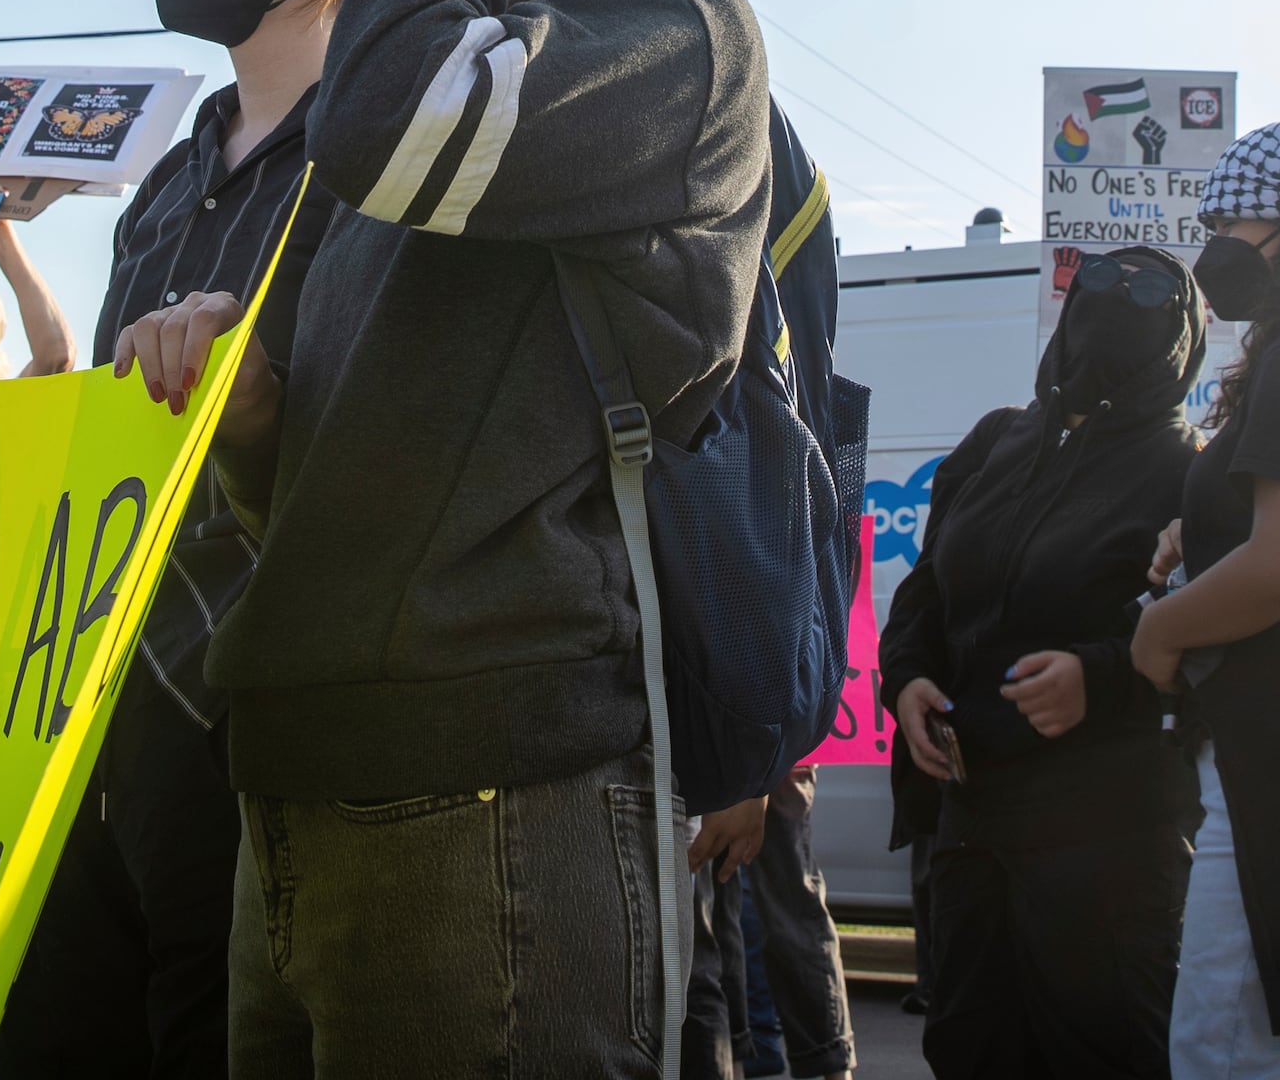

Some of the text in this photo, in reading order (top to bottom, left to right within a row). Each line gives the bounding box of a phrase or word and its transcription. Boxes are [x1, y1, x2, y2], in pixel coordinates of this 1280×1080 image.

[1189, 100, 1216, 115] ICE
[1092, 168, 1156, 197] ONE'S
[1167, 171, 1205, 198] FRE
[1109, 197, 1165, 219] UNTIL
[1045, 211, 1169, 243] EVERYONE'S
[867, 498, 917, 535] bc
[3, 476, 148, 744] AB
